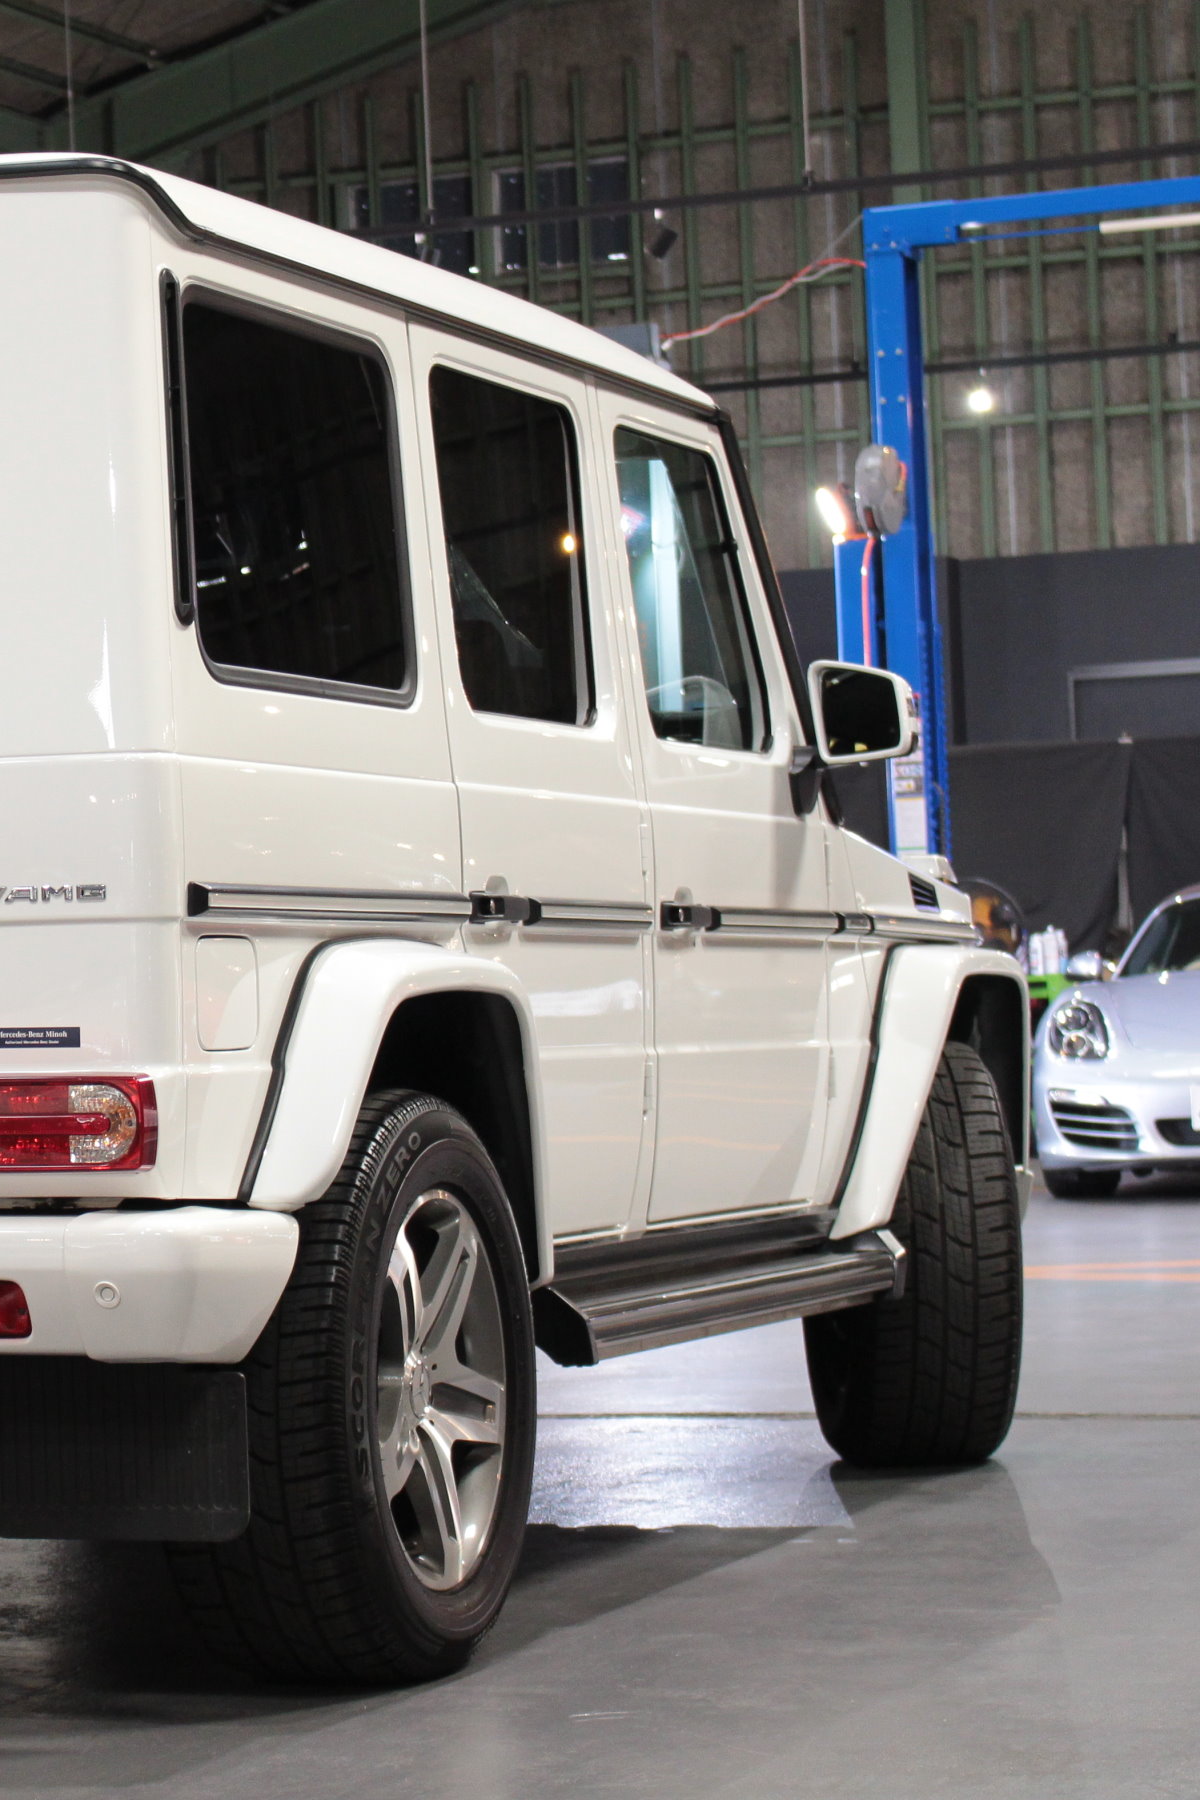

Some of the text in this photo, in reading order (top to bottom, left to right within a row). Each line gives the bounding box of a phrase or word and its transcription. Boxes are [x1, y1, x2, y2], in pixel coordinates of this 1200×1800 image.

[5, 883, 106, 903] AMG
[45, 1030, 68, 1038] Minoh
[376, 1131, 421, 1217] ZERO
